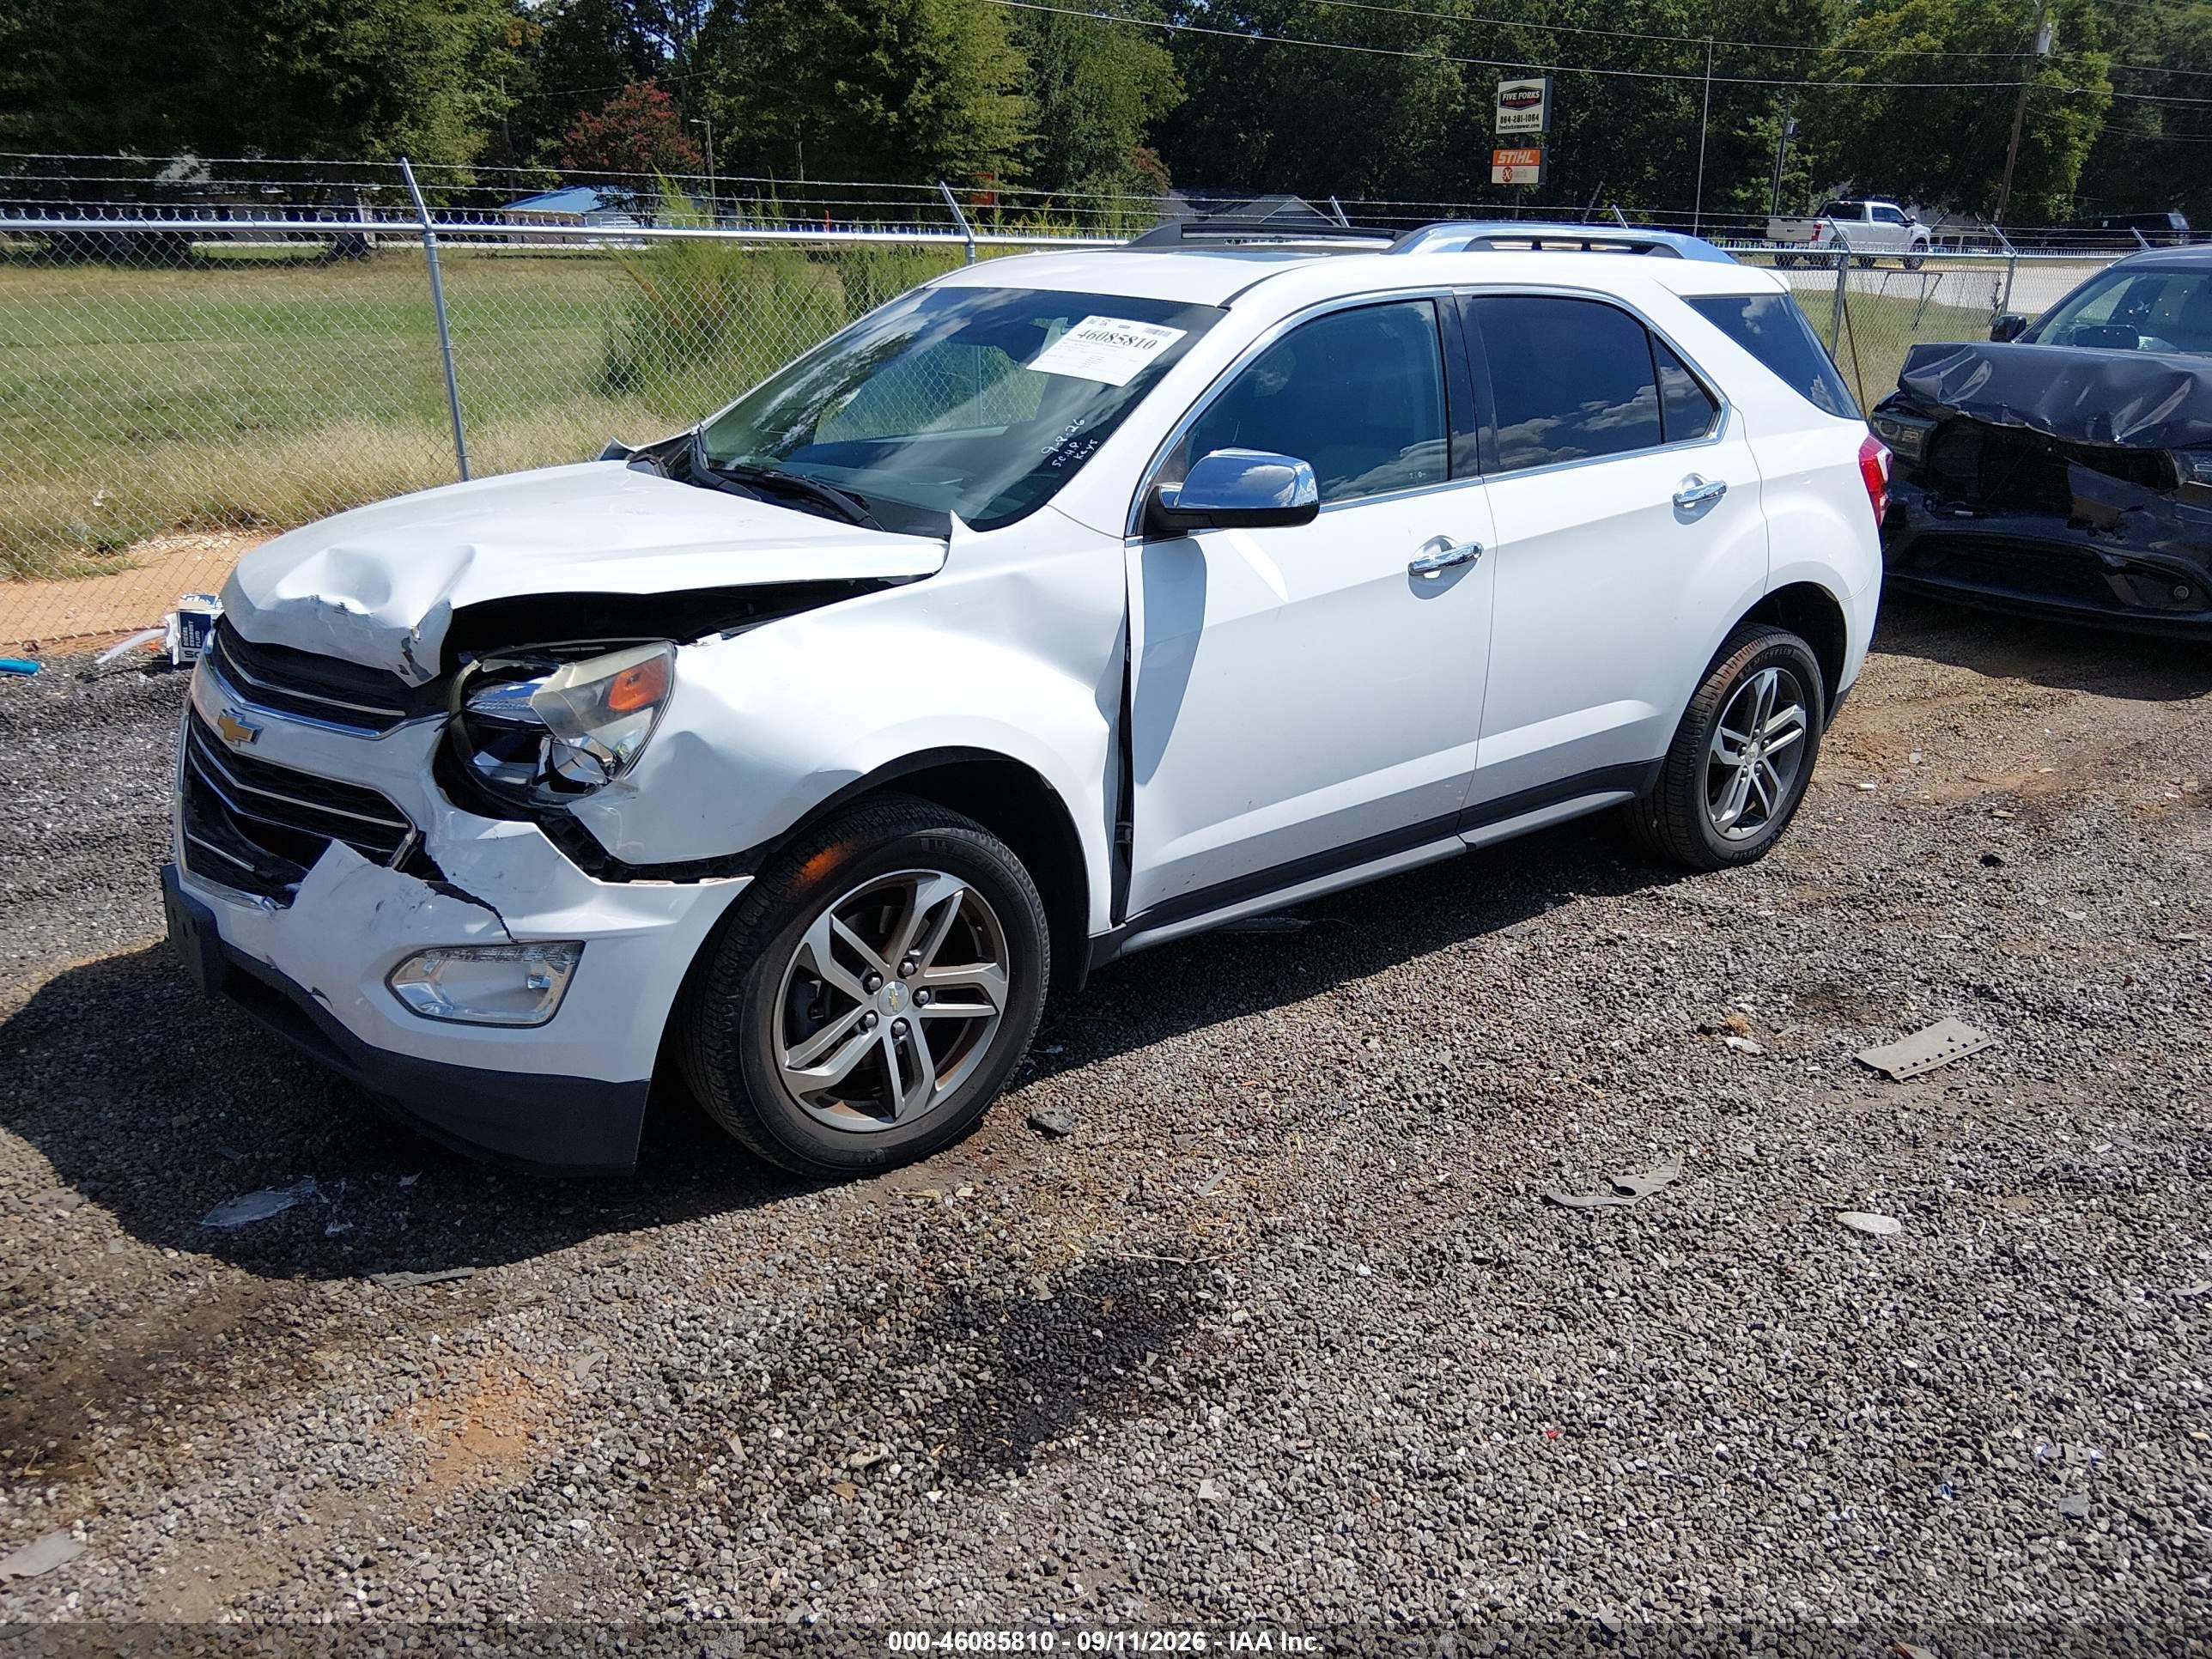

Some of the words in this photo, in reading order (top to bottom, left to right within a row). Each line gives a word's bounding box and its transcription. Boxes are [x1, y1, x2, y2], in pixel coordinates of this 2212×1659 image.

[1503, 93, 1516, 101] FIVE
[1518, 91, 1540, 100] FORKS
[1500, 113, 1540, 124] 864-281-1064
[1497, 150, 1534, 163] STIHL
[1078, 329, 1158, 350] 46085810
